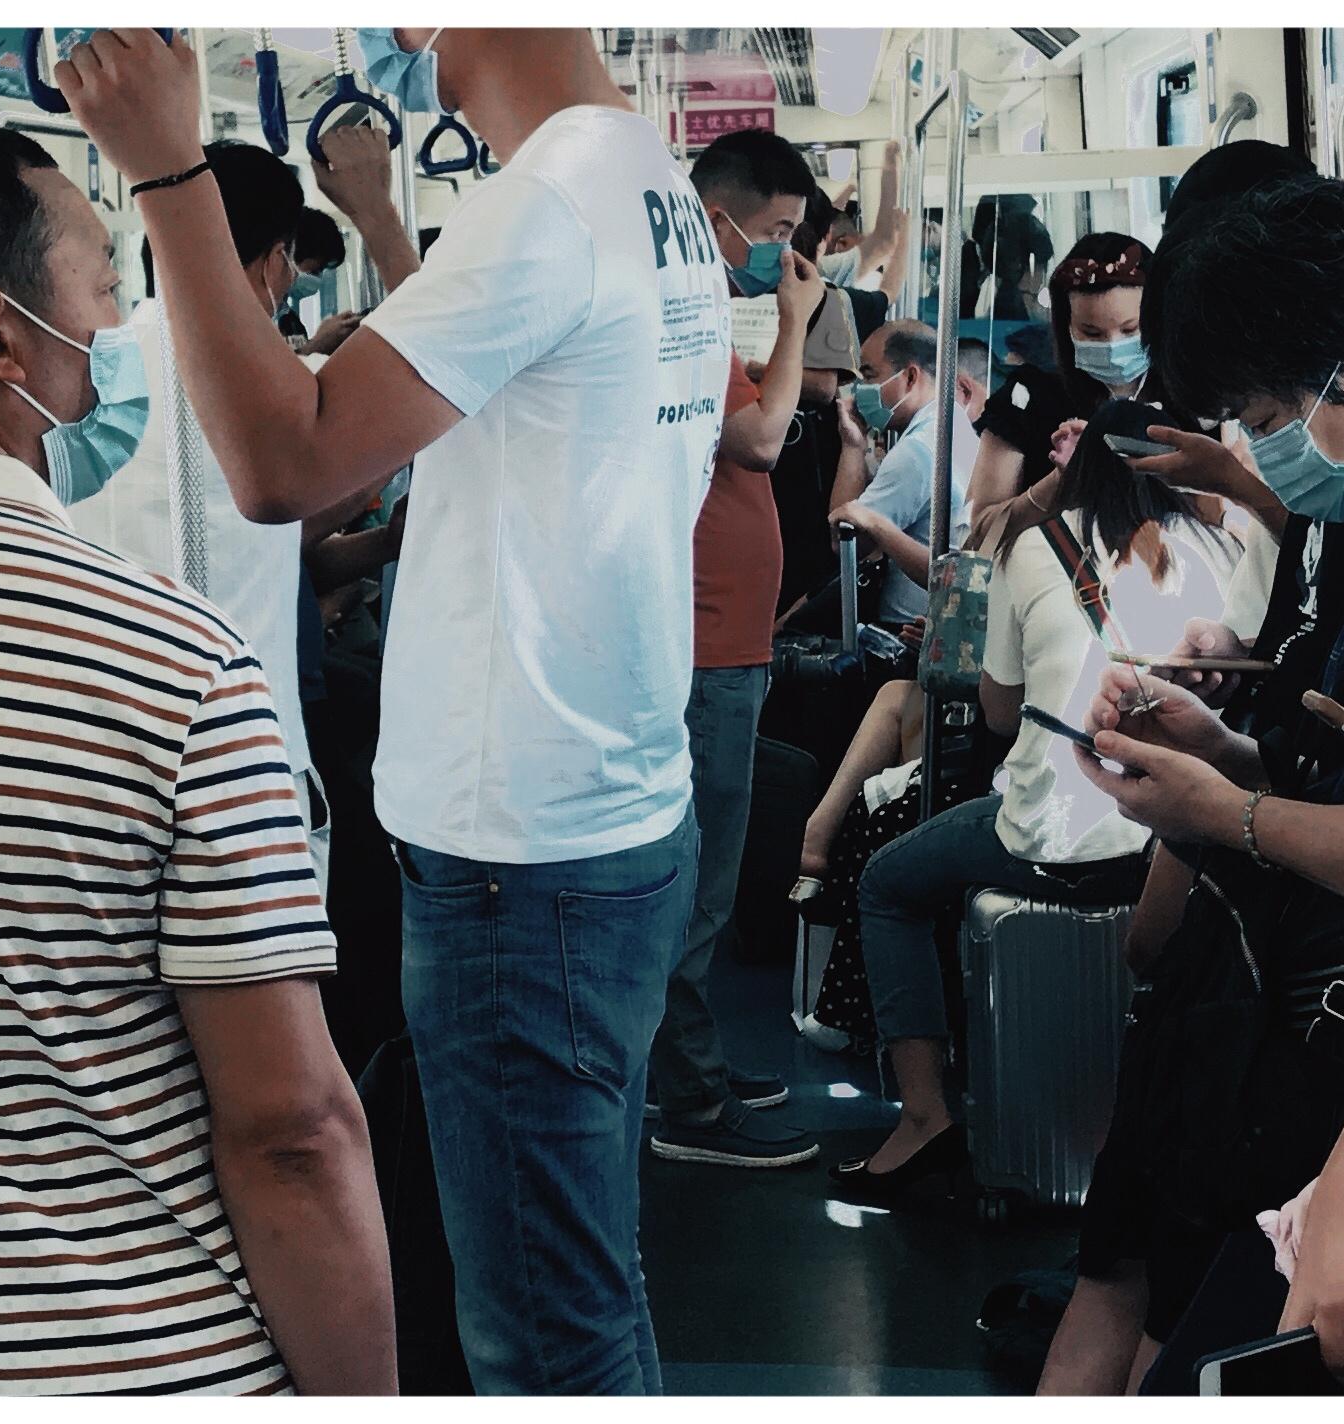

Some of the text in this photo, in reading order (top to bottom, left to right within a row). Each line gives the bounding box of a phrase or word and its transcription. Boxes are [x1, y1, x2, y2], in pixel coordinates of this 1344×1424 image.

[684, 112, 770, 130] 士优先车厢
